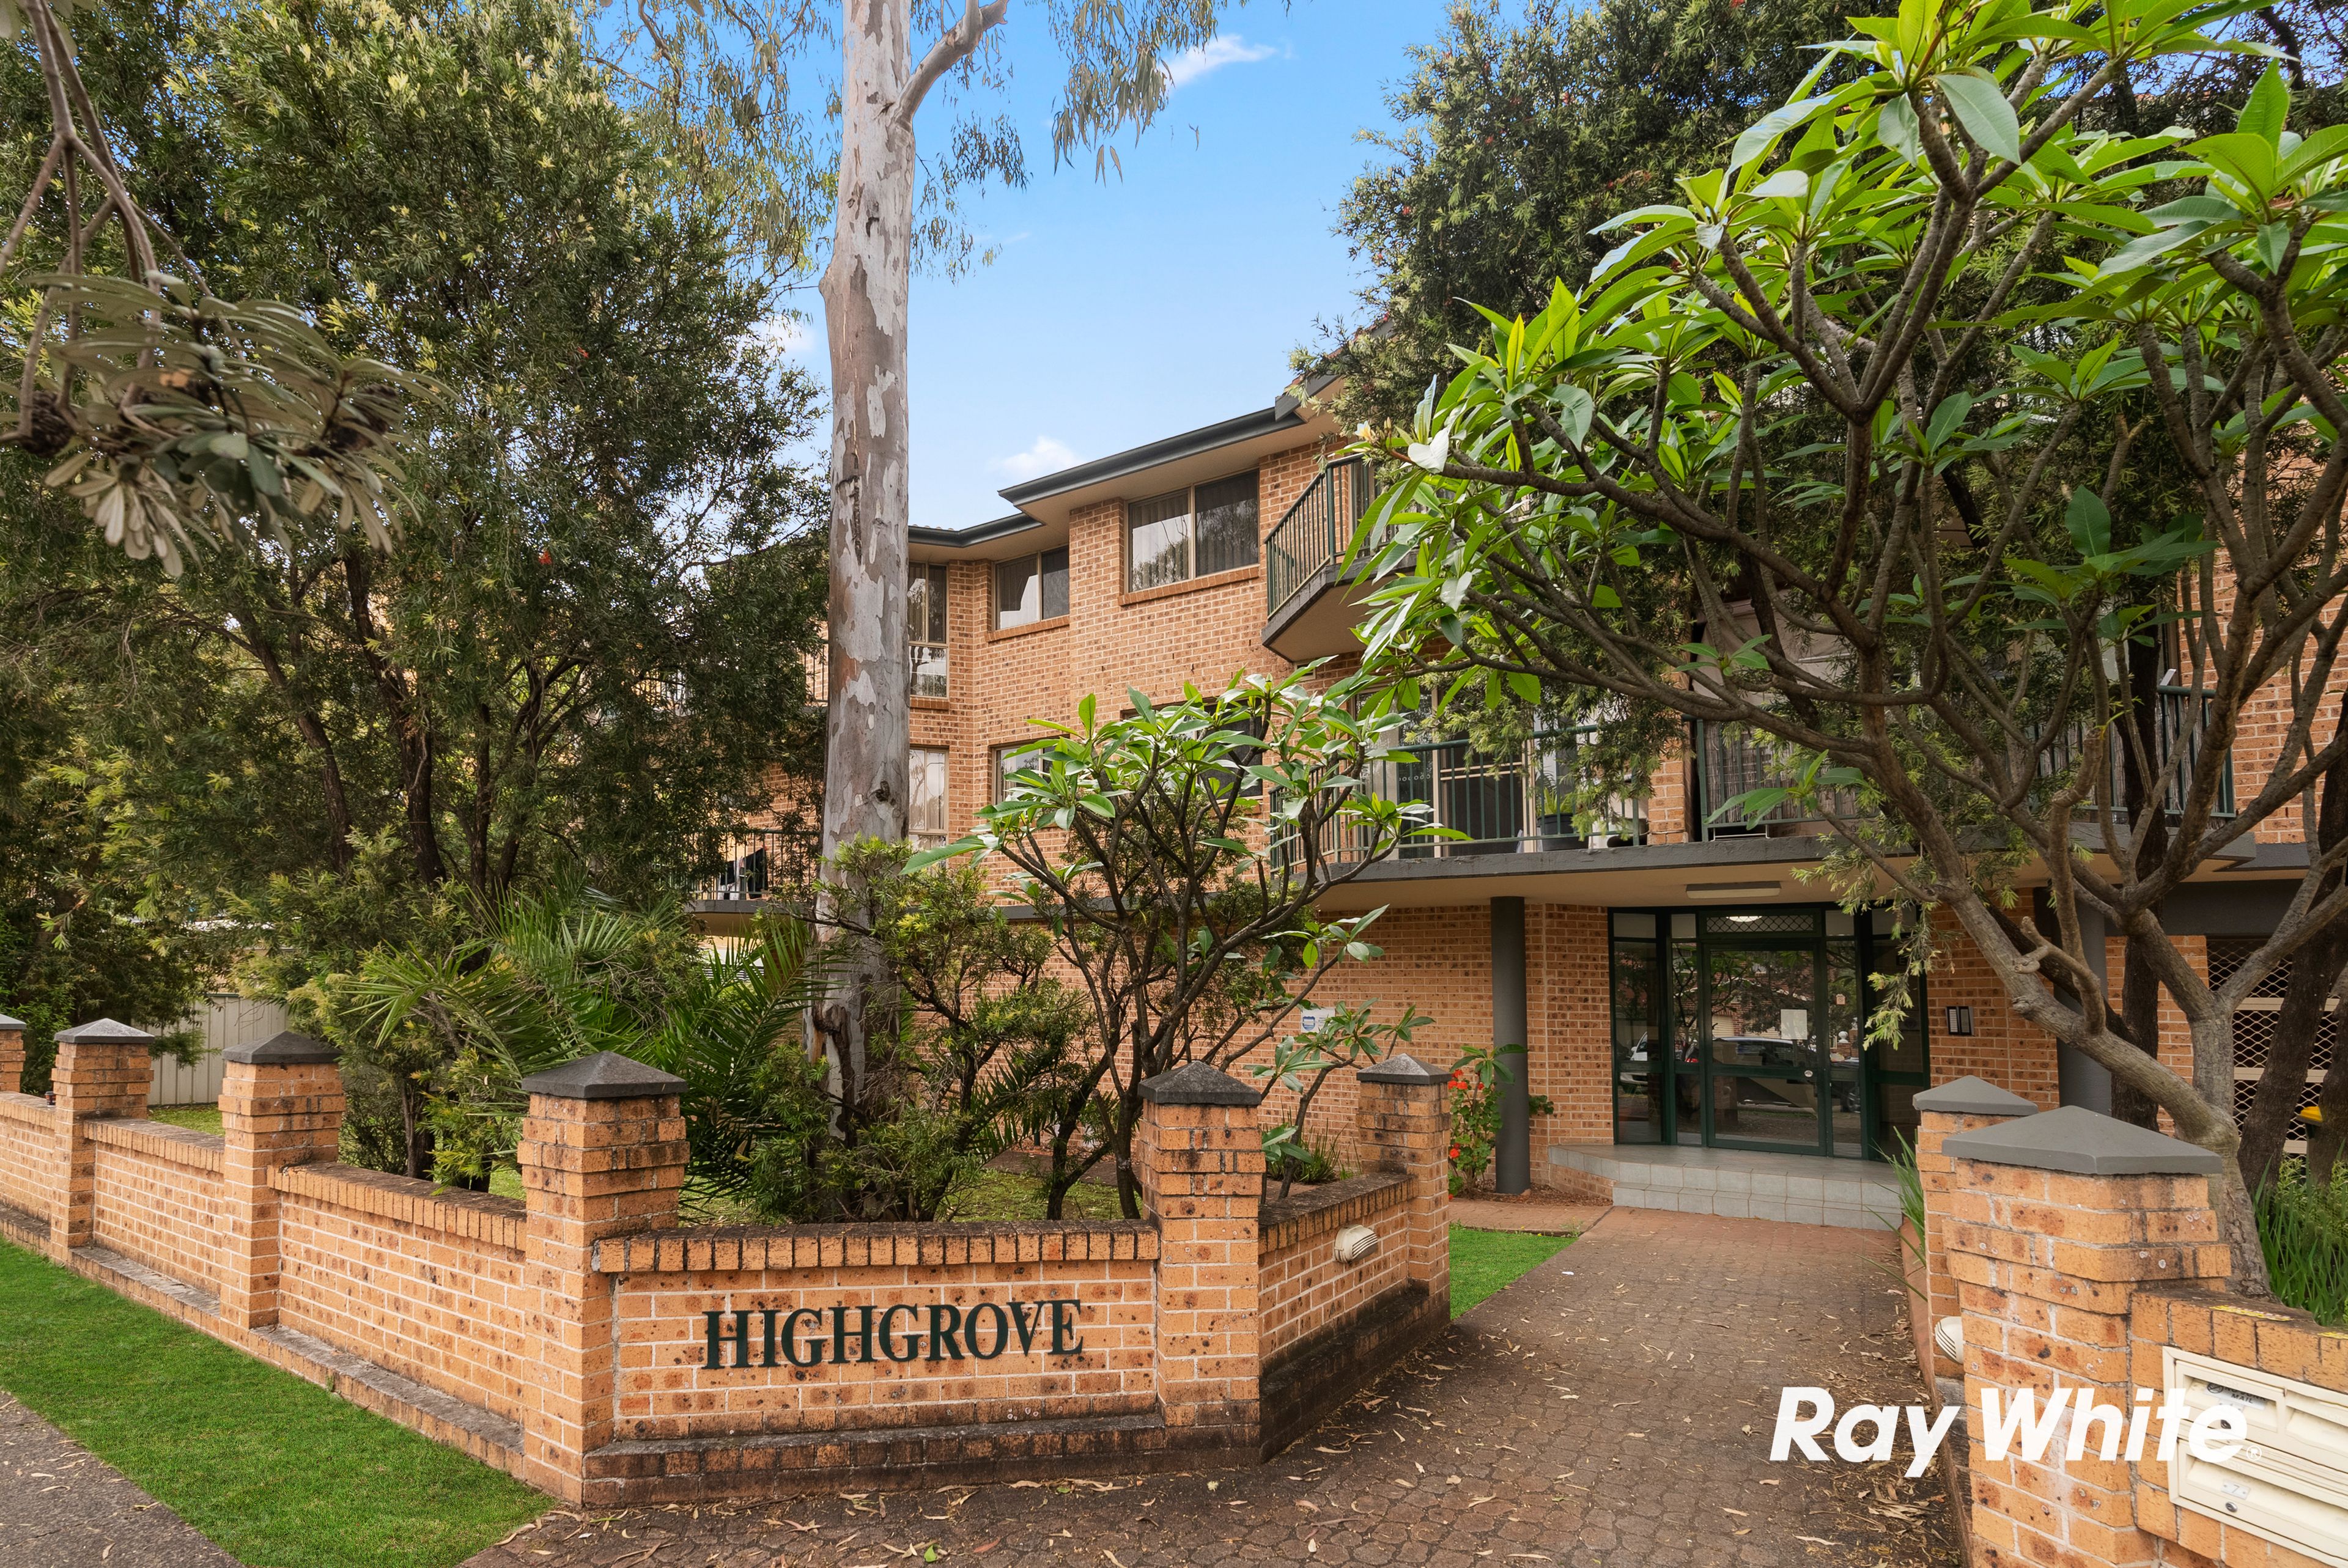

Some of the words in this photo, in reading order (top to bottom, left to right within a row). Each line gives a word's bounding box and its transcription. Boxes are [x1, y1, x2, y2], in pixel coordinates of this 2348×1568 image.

[701, 1299, 1084, 1370] HIGHGROVE
[2231, 1393, 2253, 1404] MAIL
[2232, 1484, 2240, 1493] 7
